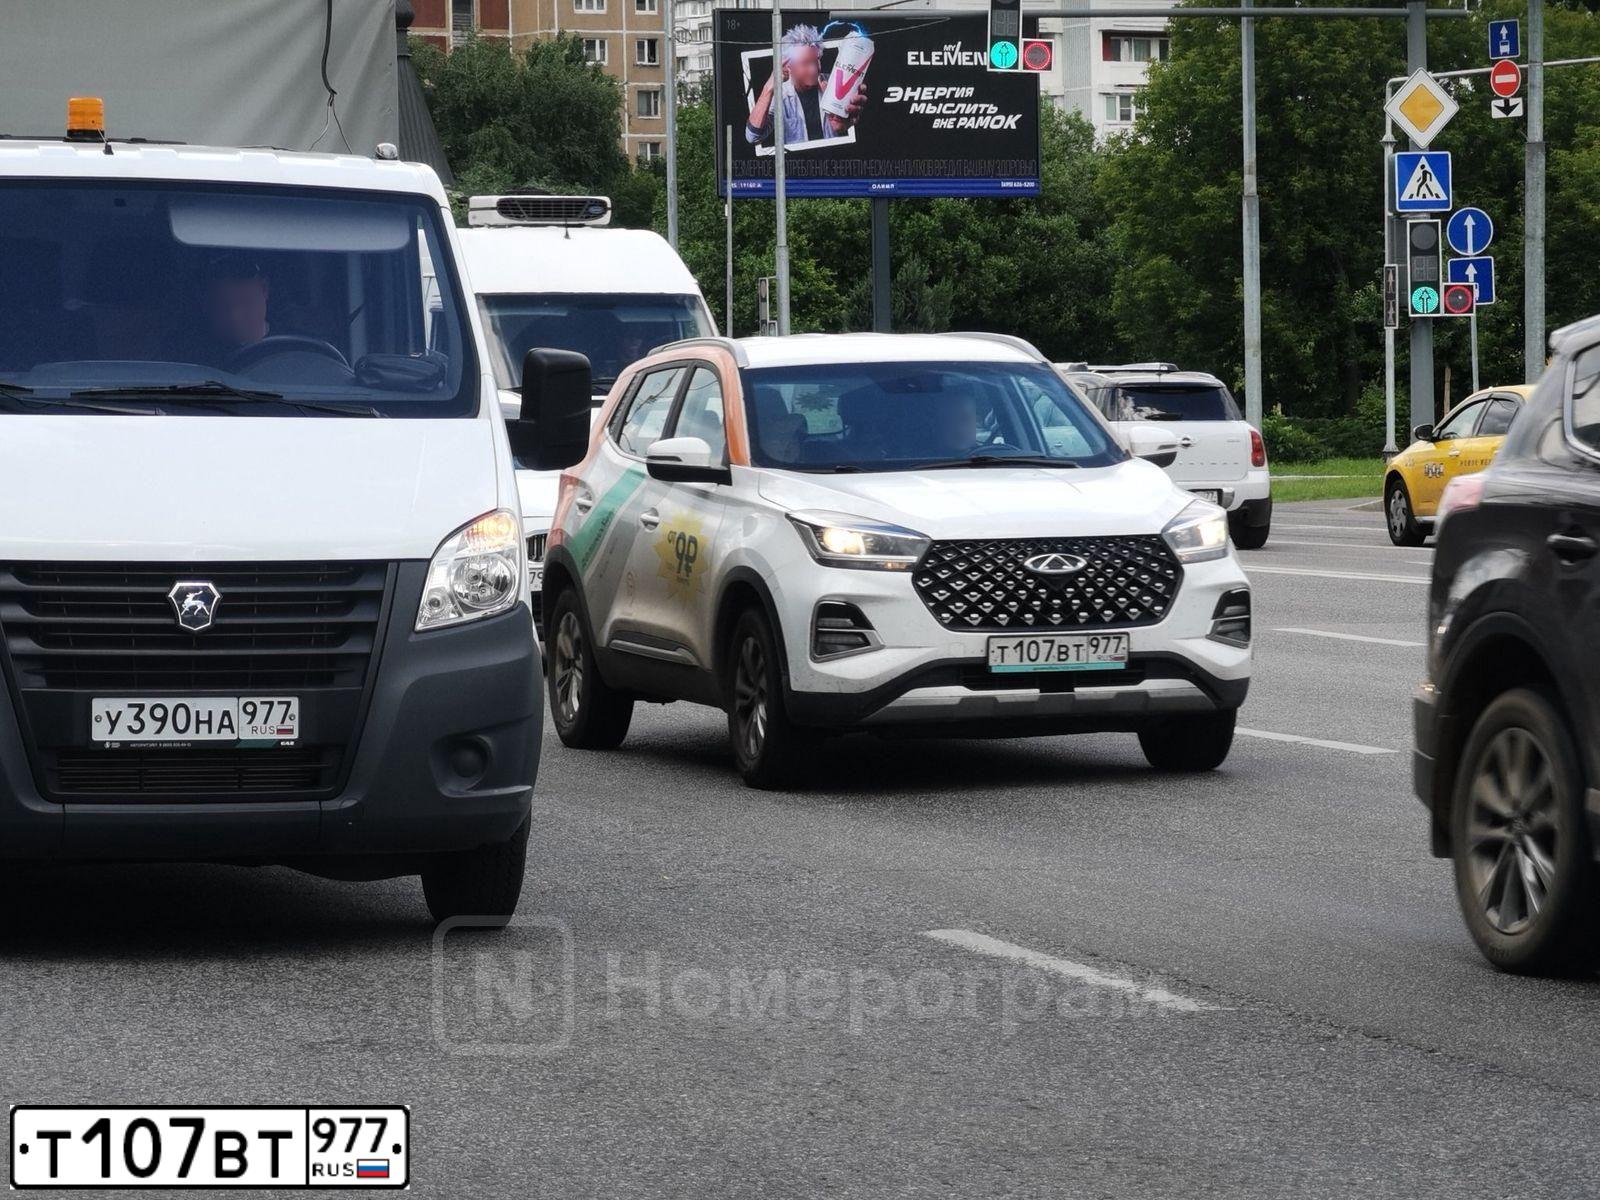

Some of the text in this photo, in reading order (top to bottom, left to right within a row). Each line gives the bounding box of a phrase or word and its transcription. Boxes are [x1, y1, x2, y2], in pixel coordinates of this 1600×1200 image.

[907, 41, 988, 66] ELEMEN
[883, 86, 975, 103] ЭНЕРГИЯ
[909, 103, 998, 114] МЫСЛИТЬ
[932, 114, 1022, 129] ВНЕ РАМОК
[997, 636, 1123, 663] Т107ВТ 977
[105, 700, 292, 735] У390НА 977
[251, 725, 275, 735] RUS
